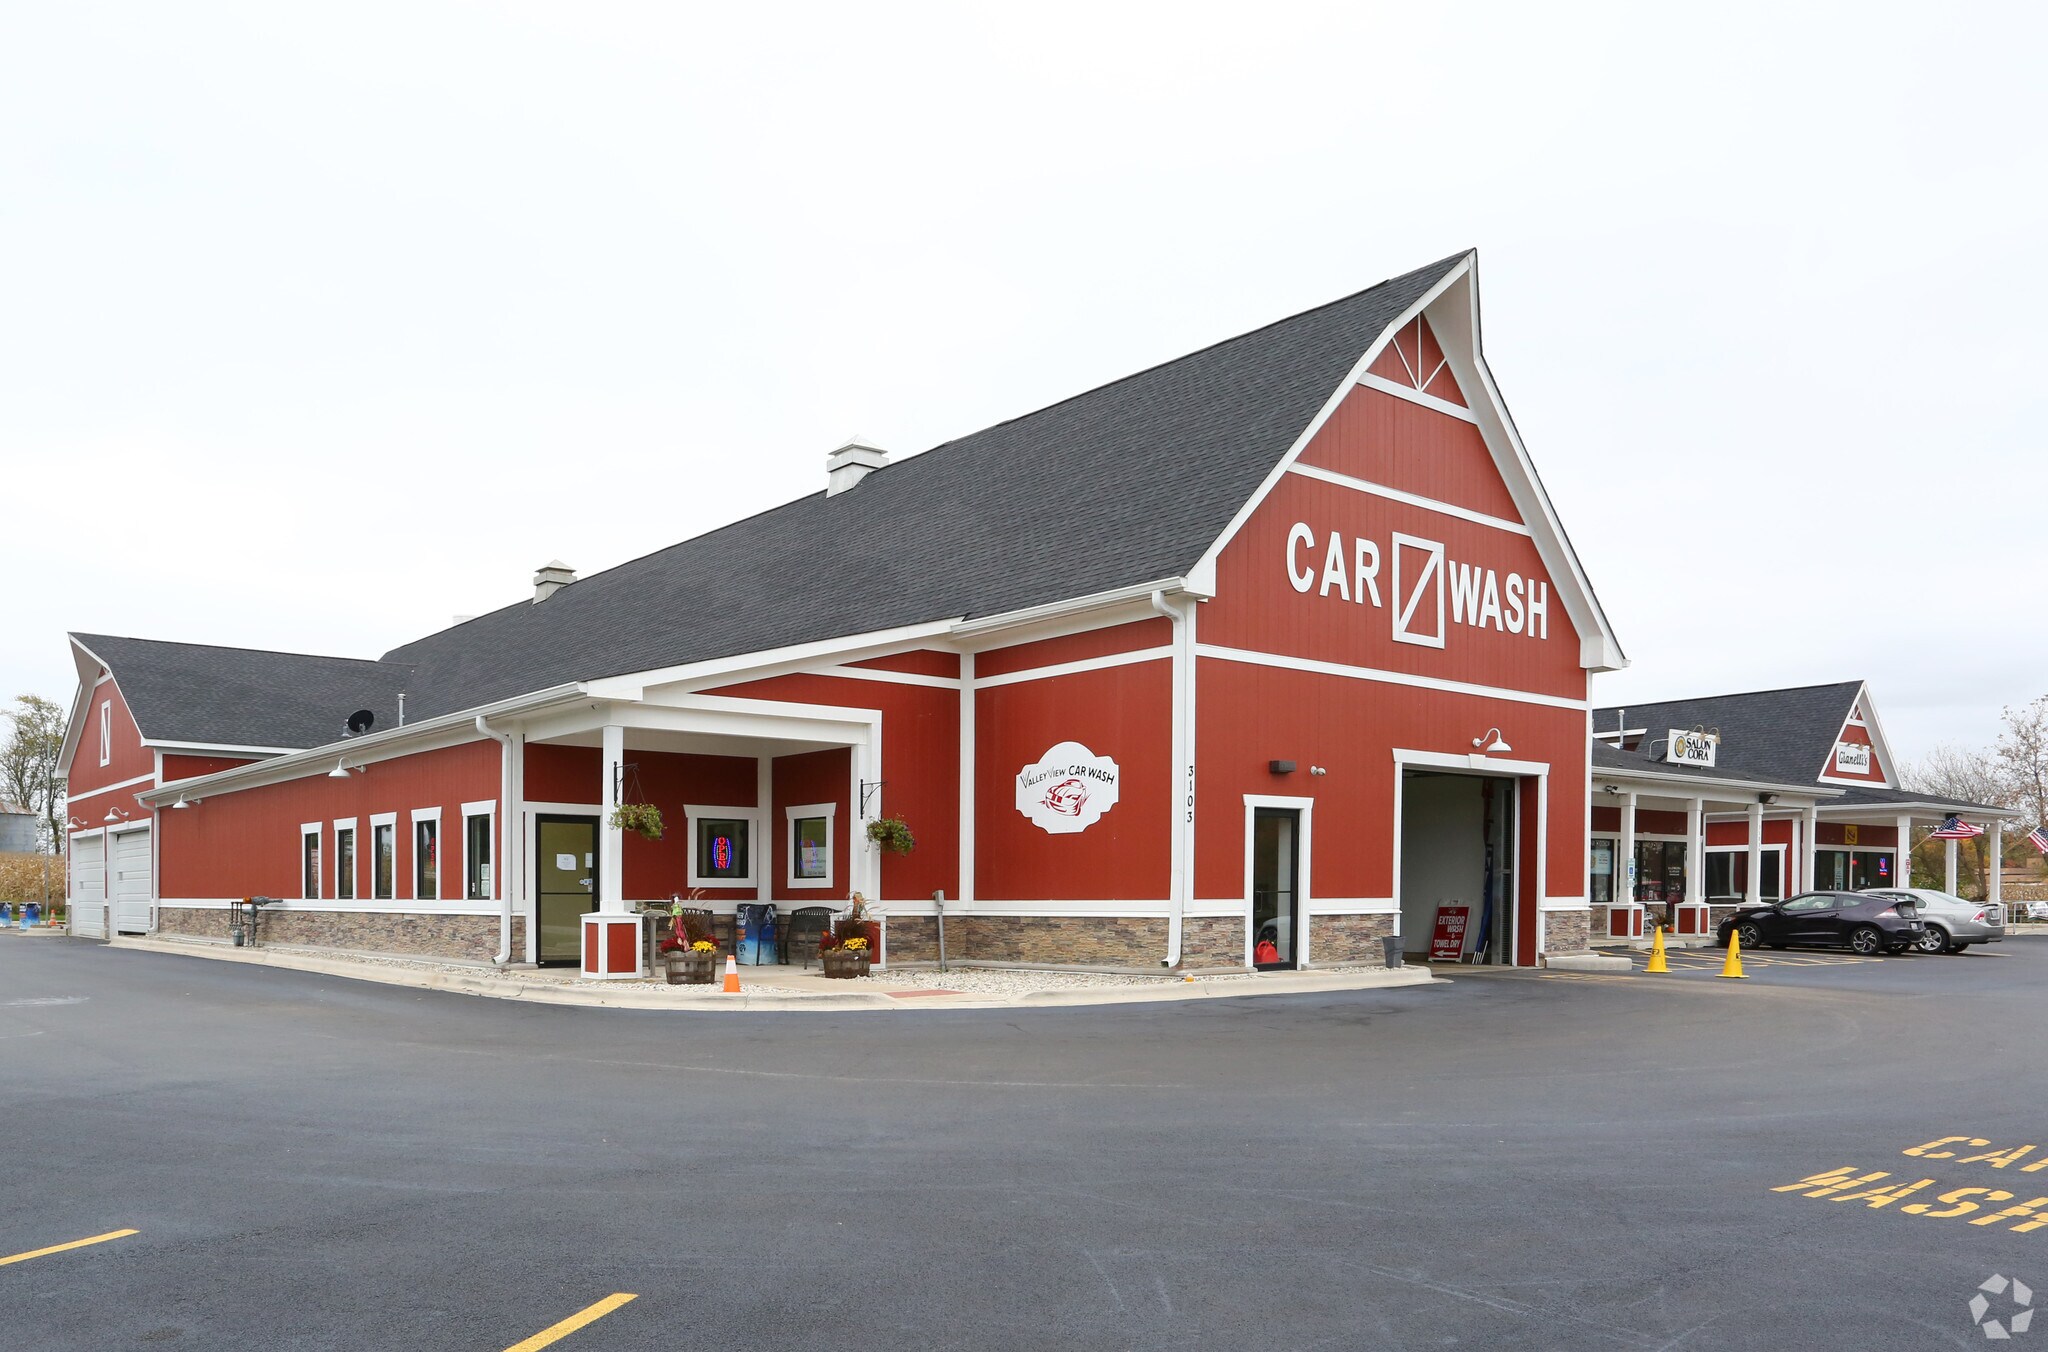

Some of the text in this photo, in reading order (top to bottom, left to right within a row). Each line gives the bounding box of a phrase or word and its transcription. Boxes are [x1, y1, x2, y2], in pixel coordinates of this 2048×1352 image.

[1286, 521, 1547, 640] CAR WASH
[1686, 737, 1712, 751] SALON
[1687, 748, 1709, 761] CORA
[1068, 765, 1087, 777] CAR
[1088, 766, 1115, 785] WASH
[717, 836, 727, 870] OPEN
[1438, 915, 1466, 925] EXTERIOR
[1447, 924, 1464, 933] WASH
[1433, 939, 1461, 948] TOWEL DRY
[1768, 1166, 2048, 1233] WASH
